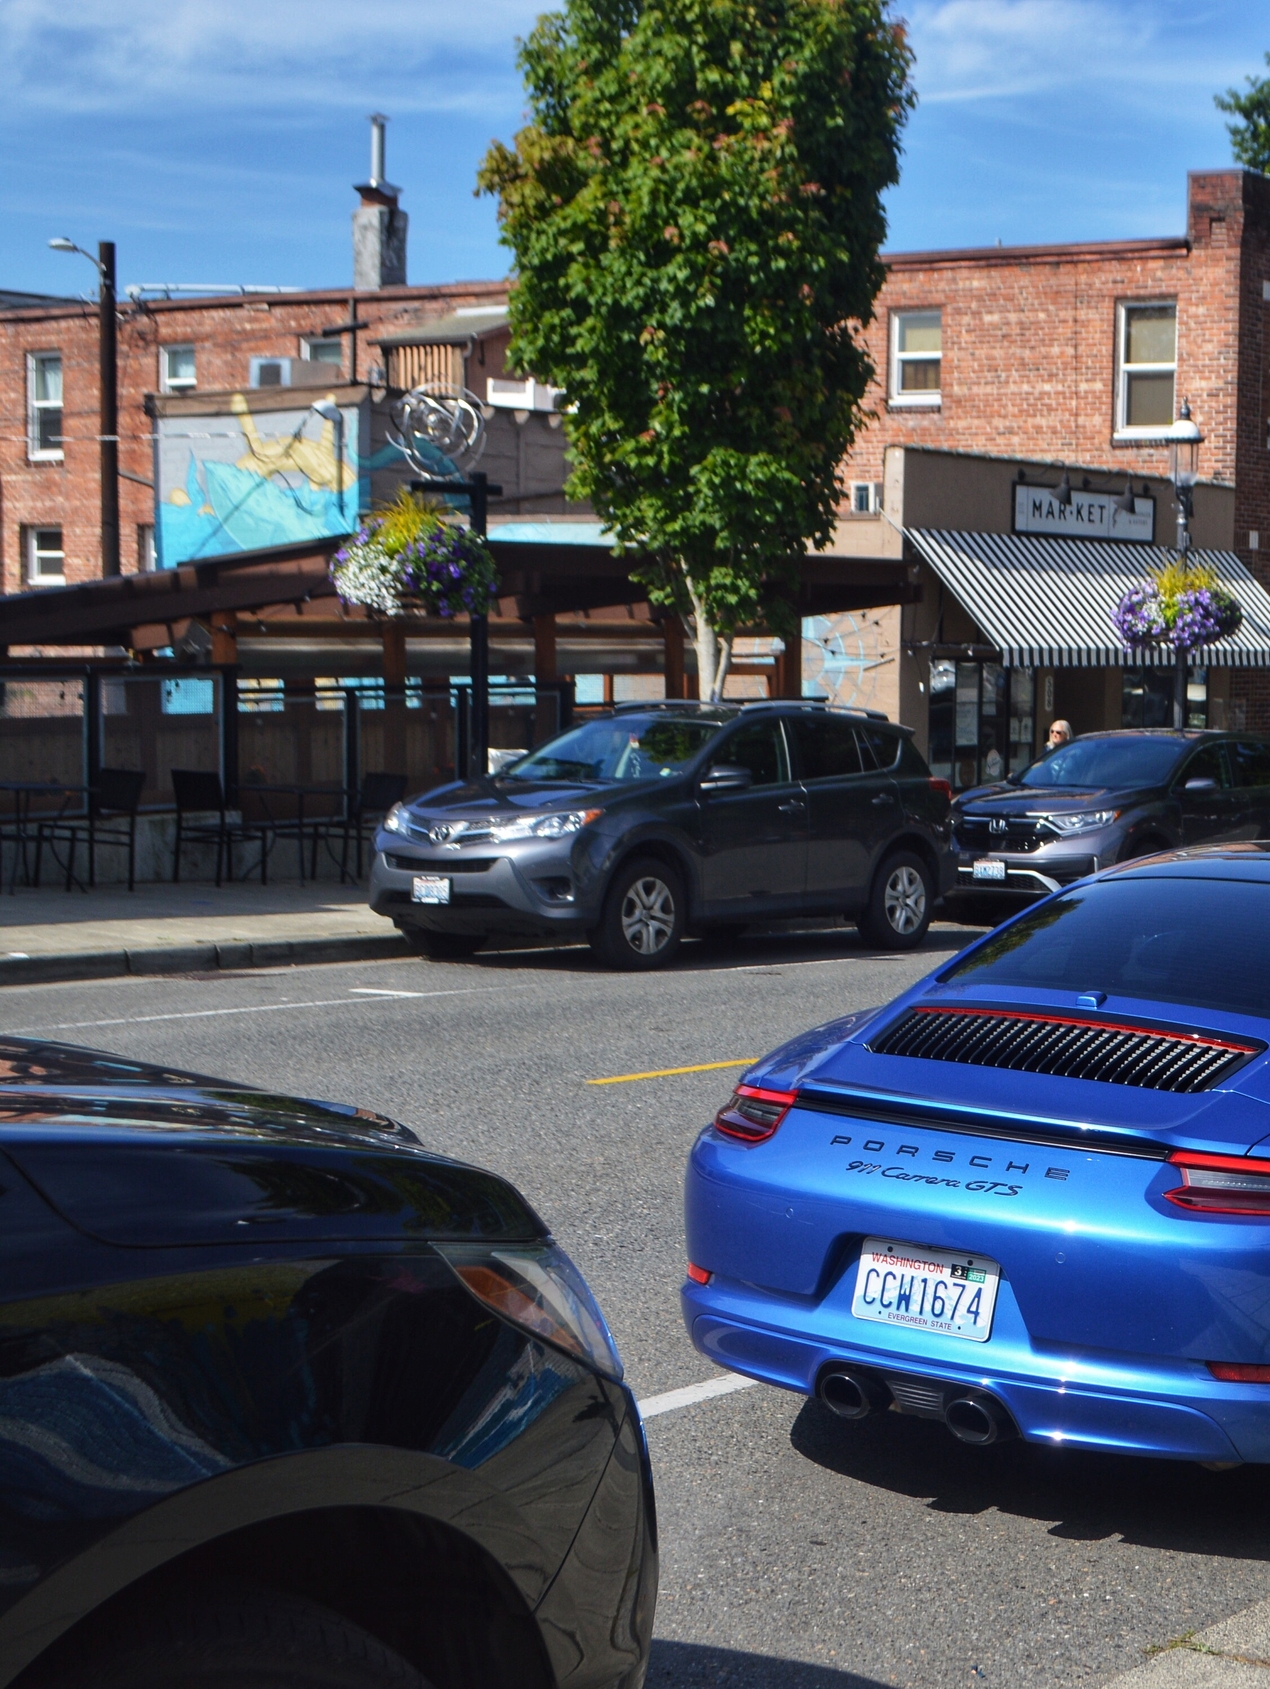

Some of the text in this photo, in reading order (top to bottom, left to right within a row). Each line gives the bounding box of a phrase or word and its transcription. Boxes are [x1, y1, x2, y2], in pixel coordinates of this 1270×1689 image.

[829, 1134, 1071, 1181] PORSCHE
[845, 1160, 1024, 1197] 911 Carrera GTS
[872, 1252, 944, 1275] WASHINGTON
[954, 1265, 962, 1276] 3
[968, 1273, 985, 1283] 2023
[863, 1267, 983, 1326] CCW1674
[887, 1311, 952, 1331] EVERGREEN STATE
